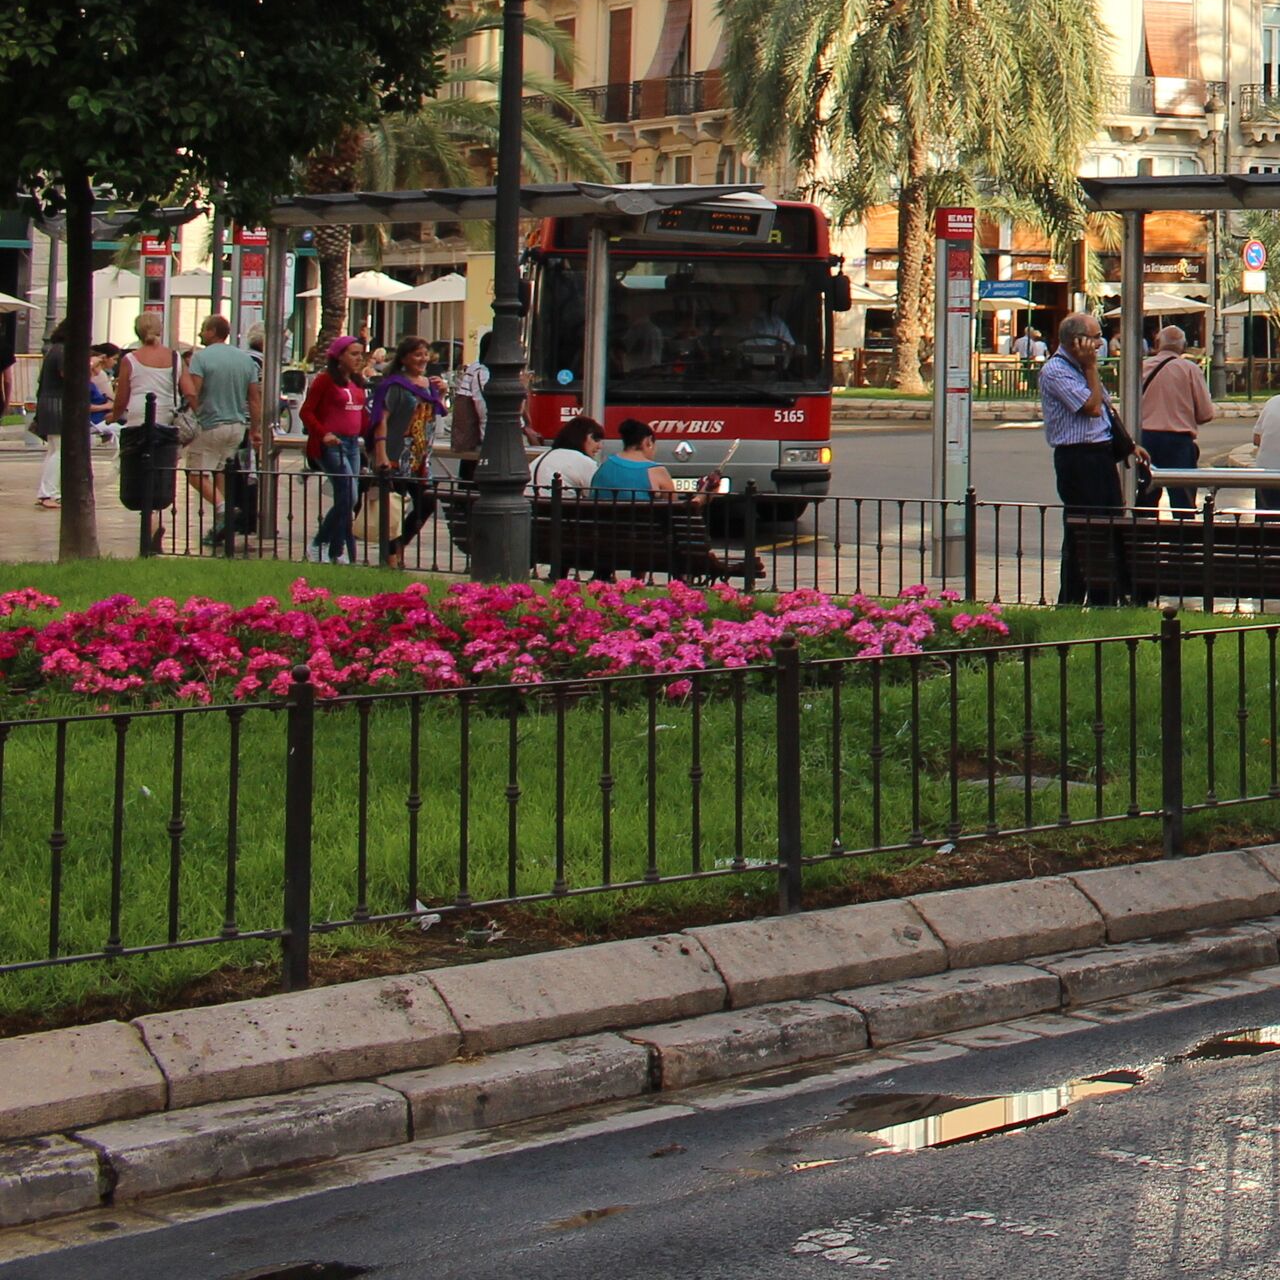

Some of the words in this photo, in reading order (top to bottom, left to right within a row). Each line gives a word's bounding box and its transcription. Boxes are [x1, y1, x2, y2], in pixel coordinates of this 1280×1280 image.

[948, 214, 973, 222] EMT
[774, 410, 804, 422] 5165
[647, 420, 725, 433] CITYBUS
